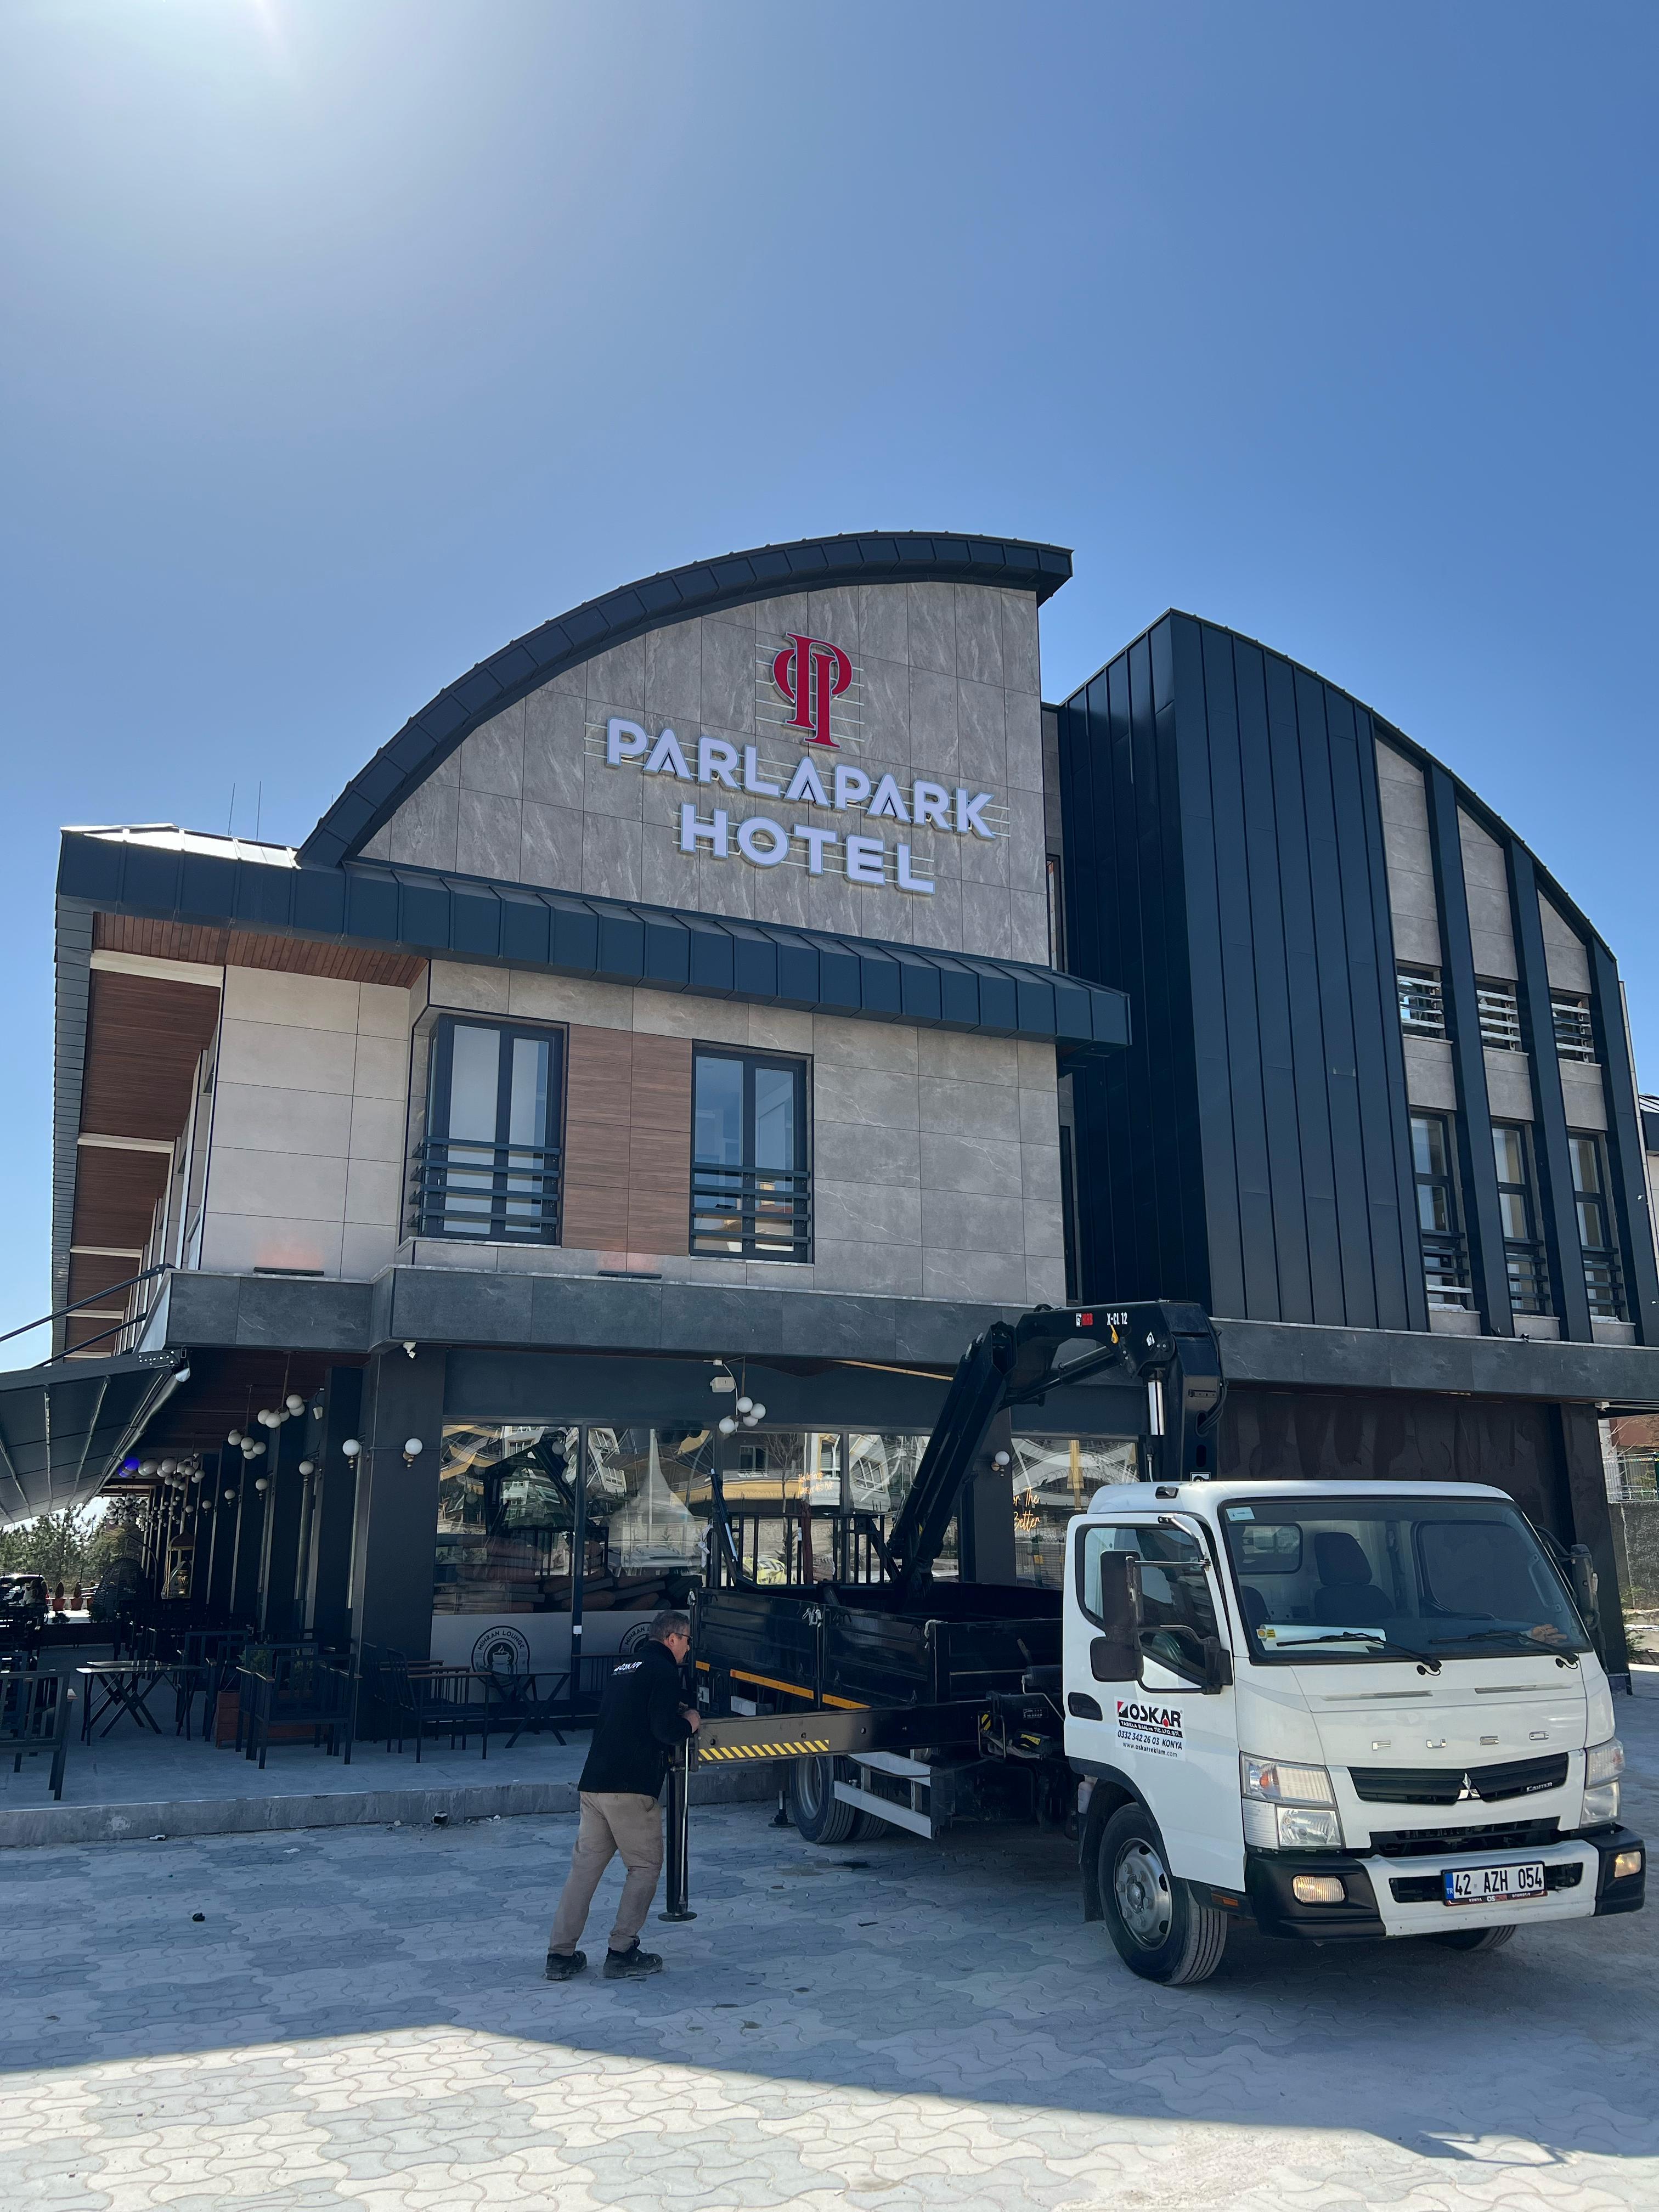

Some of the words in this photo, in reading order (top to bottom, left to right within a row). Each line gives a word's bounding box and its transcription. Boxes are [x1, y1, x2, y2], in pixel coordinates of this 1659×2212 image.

[606, 716, 995, 840] PARLAPARK
[680, 802, 935, 895] HOTEL
[1121, 1312, 1128, 1325] 12
[1013, 1510, 1040, 1532] Better
[502, 1630, 525, 1649] LOUNGE
[1121, 1720, 1137, 1729] TABELA
[1130, 1703, 1181, 1728] OSKAR
[1118, 1730, 1131, 1740] 0332
[1132, 1733, 1142, 1742] 342
[1143, 1735, 1151, 1743] 26
[1152, 1736, 1159, 1745] 03
[1162, 1739, 1183, 1750] KONYA
[1122, 1742, 1177, 1758] www.oskarreklam.com
[1372, 1731, 1549, 1751] FUSO
[1526, 1782, 1553, 1792] CANTER
[1455, 1874, 1471, 1895] 42
[1484, 1870, 1508, 1893] AZH
[1518, 1866, 1542, 1889] 054
